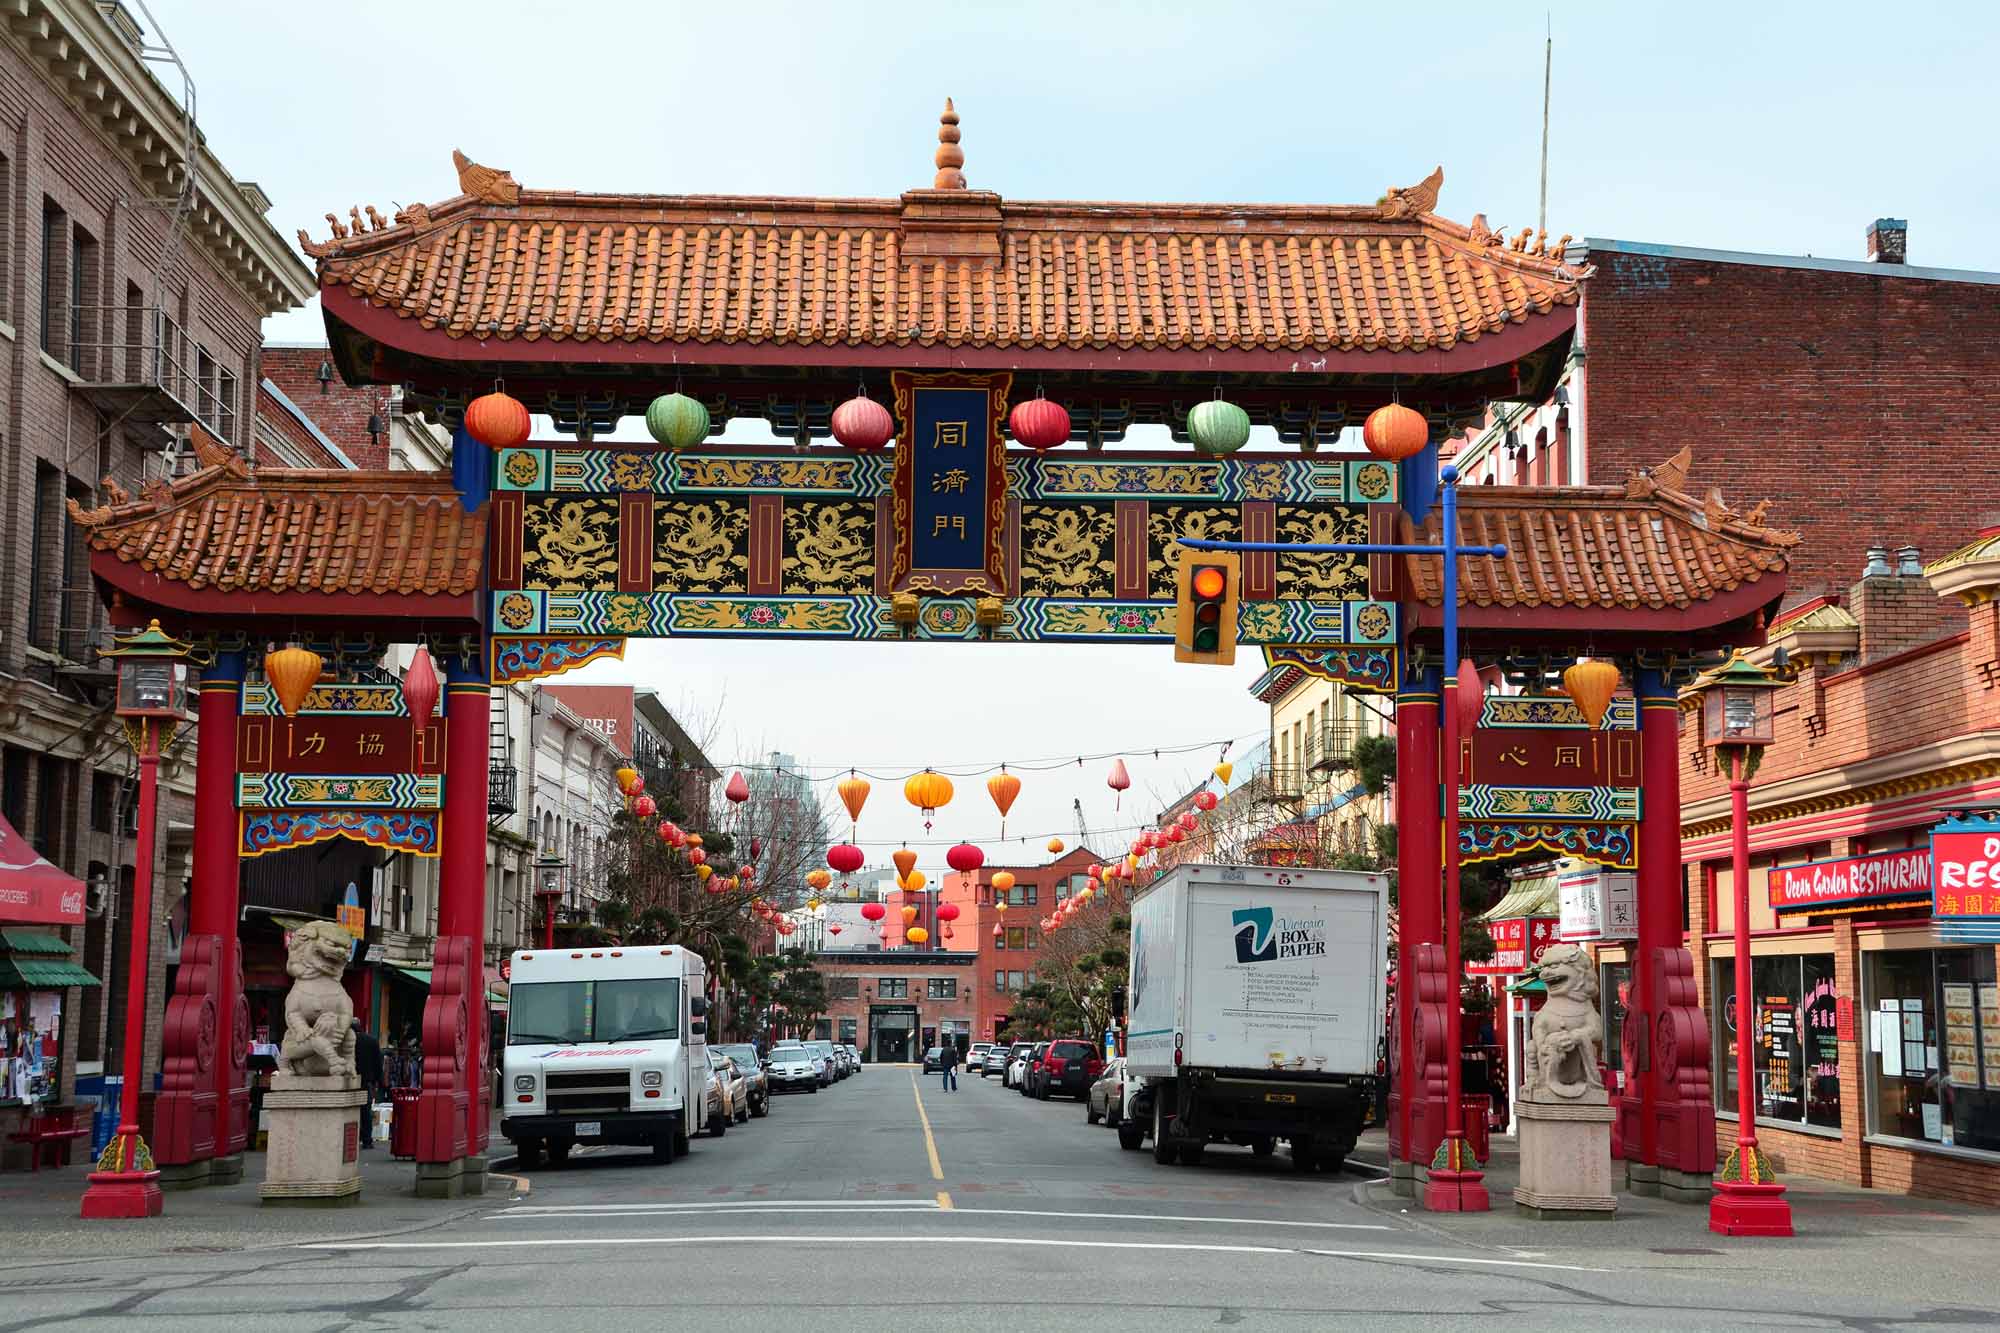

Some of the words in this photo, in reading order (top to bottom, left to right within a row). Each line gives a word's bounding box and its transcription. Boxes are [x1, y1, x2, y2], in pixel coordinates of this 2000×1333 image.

[932, 420, 970, 541] 同濟門
[1785, 871, 1811, 899] Ocean
[1813, 864, 1848, 895] Garden
[1280, 941, 1326, 958] PAPER
[1281, 930, 1310, 944] BOX
